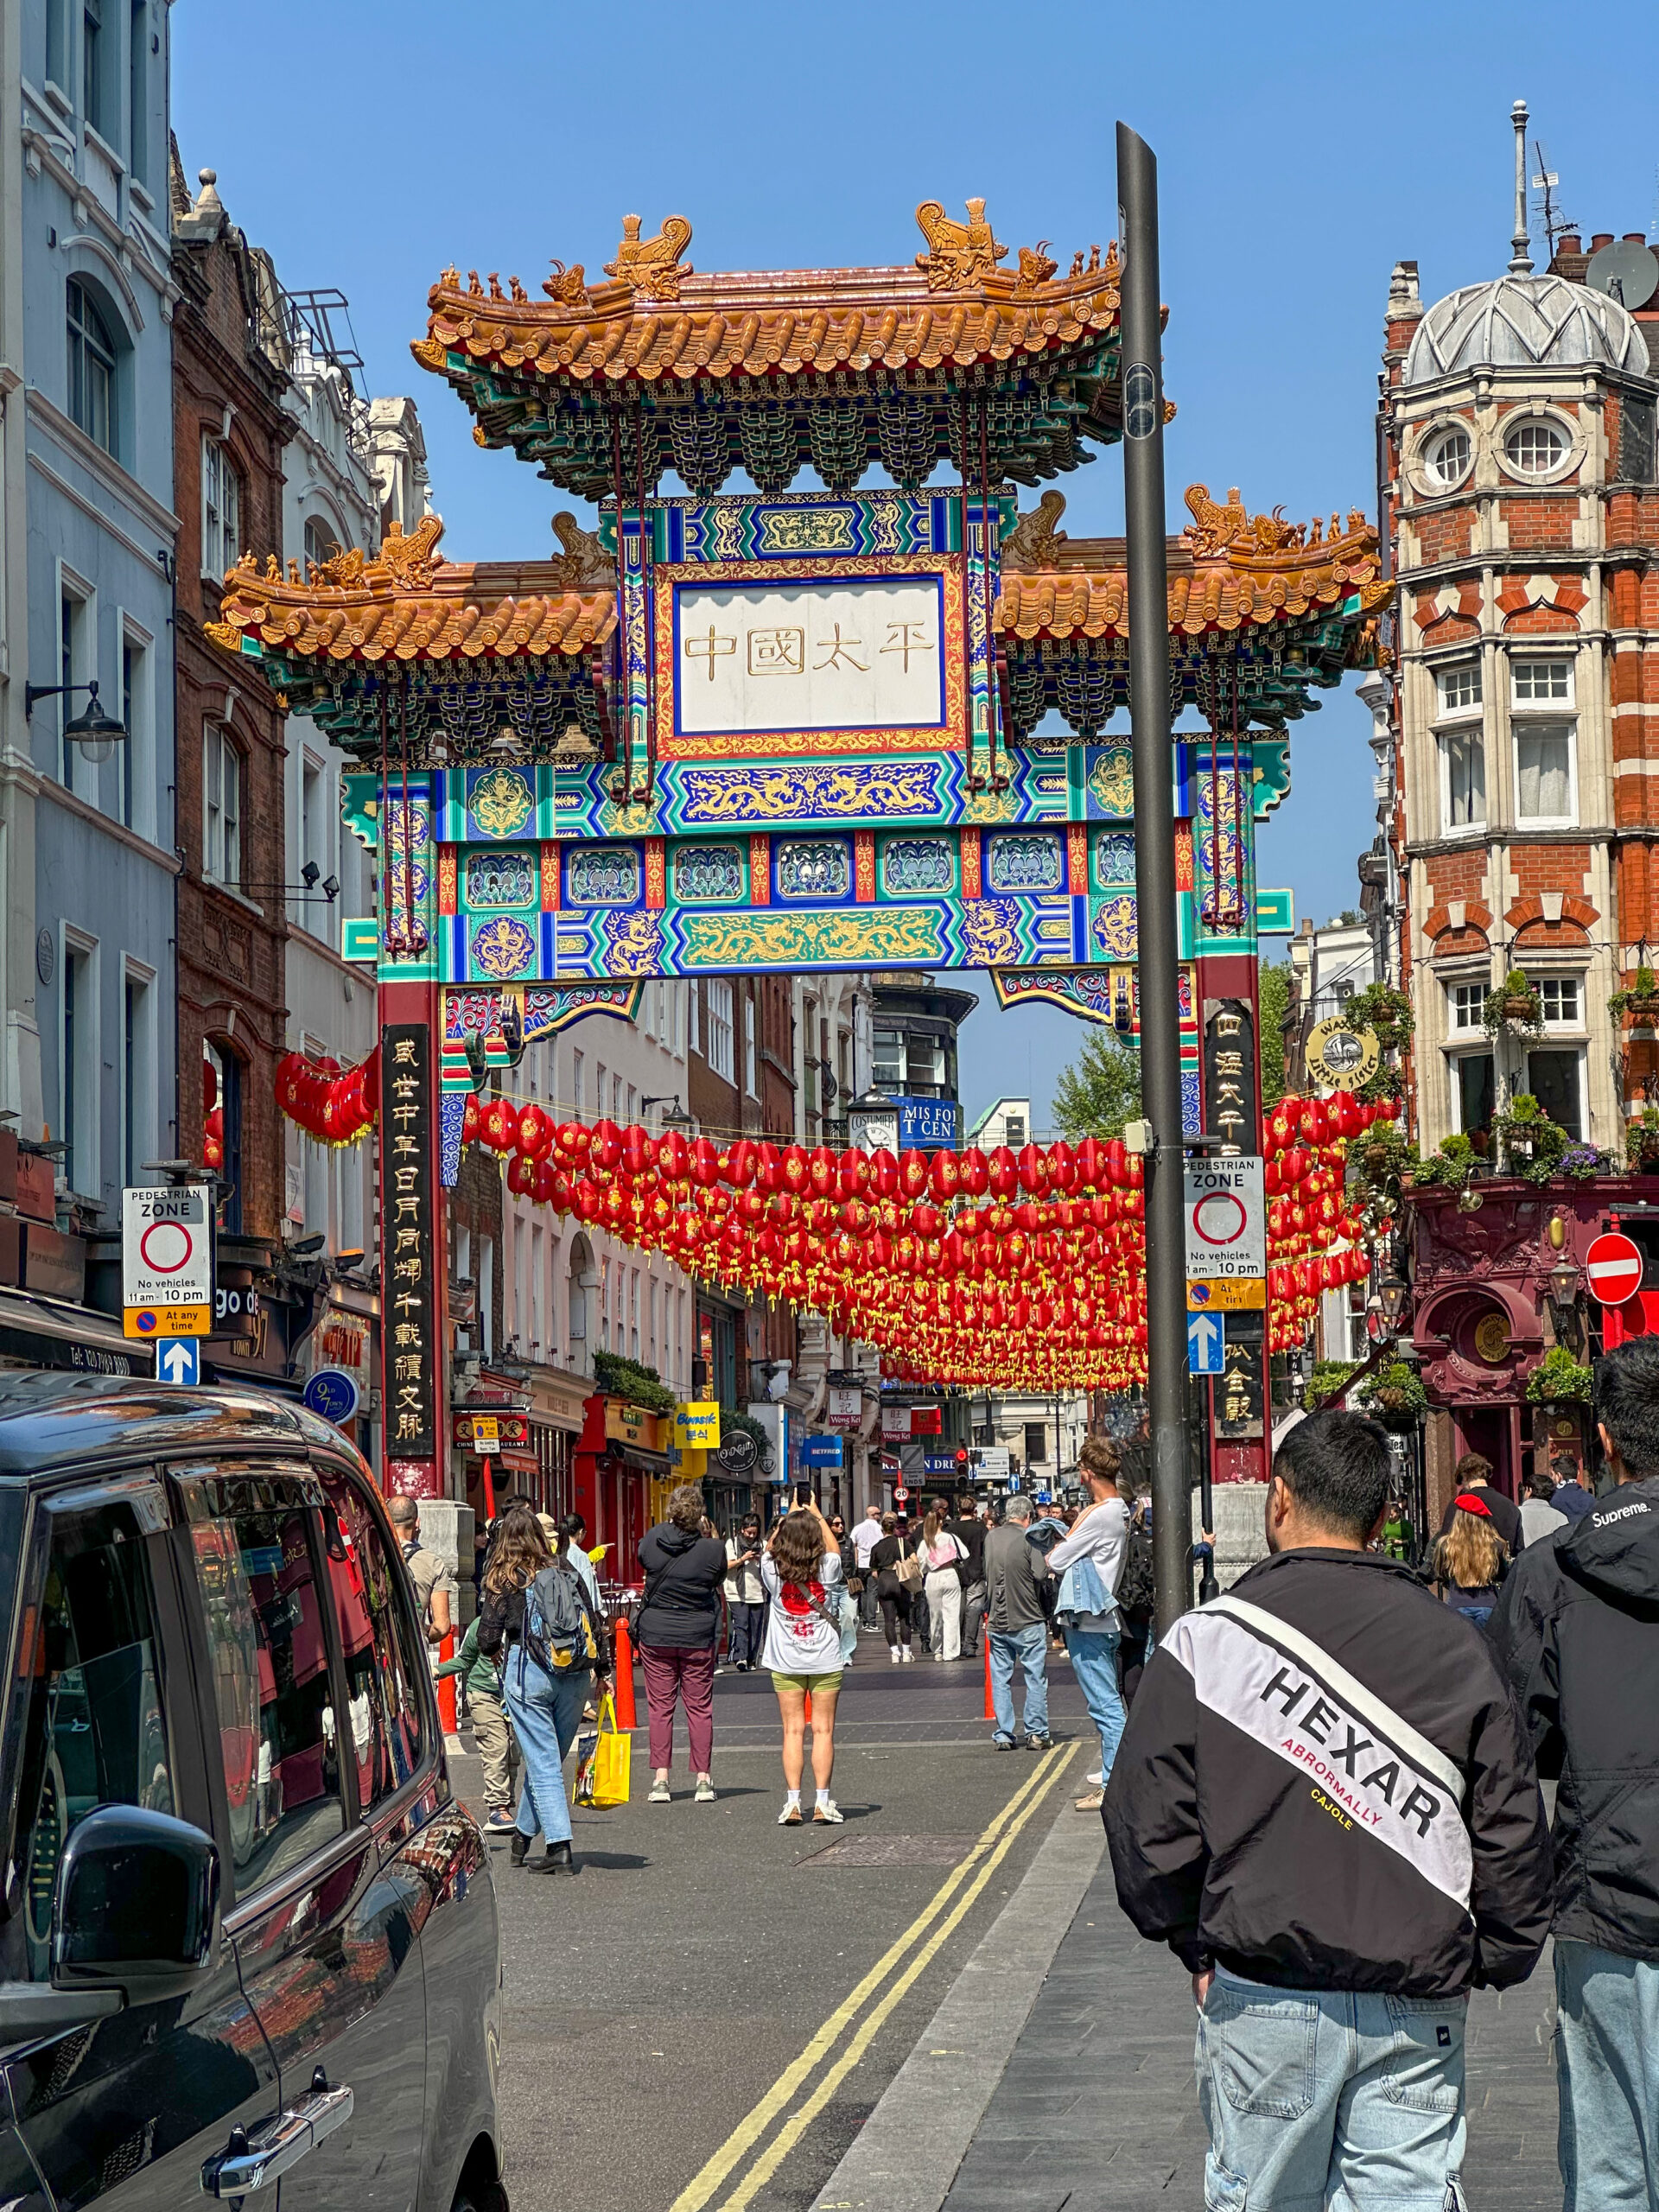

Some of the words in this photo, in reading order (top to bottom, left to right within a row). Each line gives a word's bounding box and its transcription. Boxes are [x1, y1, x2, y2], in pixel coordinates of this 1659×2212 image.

[684, 620, 934, 682] 中國太平
[851, 1115, 894, 1131] COSTUMIER
[921, 1121, 957, 1137] CEN
[1184, 1160, 1255, 1171] PEDESTRIAN
[1193, 1173, 1244, 1188] ZONE
[131, 1190, 200, 1201] PEDESTRIAN
[141, 1202, 190, 1217] ZONE
[1191, 1251, 1205, 1261] No
[1209, 1250, 1251, 1261] vehicles
[1218, 1262, 1234, 1274] 10
[1238, 1264, 1259, 1275] pm
[138, 1280, 152, 1288] No
[156, 1278, 196, 1288] vehicles
[164, 1290, 180, 1301] 10
[184, 1291, 203, 1302] pm
[166, 1312, 179, 1320] At
[181, 1313, 199, 1321] any
[171, 1321, 194, 1331] time
[71, 1347, 84, 1365] Tel:
[839, 1391, 853, 1414] 旺記
[883, 1432, 900, 1440] Wong
[720, 1441, 754, 1459] O'Neill's
[1259, 1666, 1441, 1839] HEXAR
[1281, 1738, 1383, 1827] ABRORMALLY
[1310, 1789, 1353, 1831] CAJOLE
